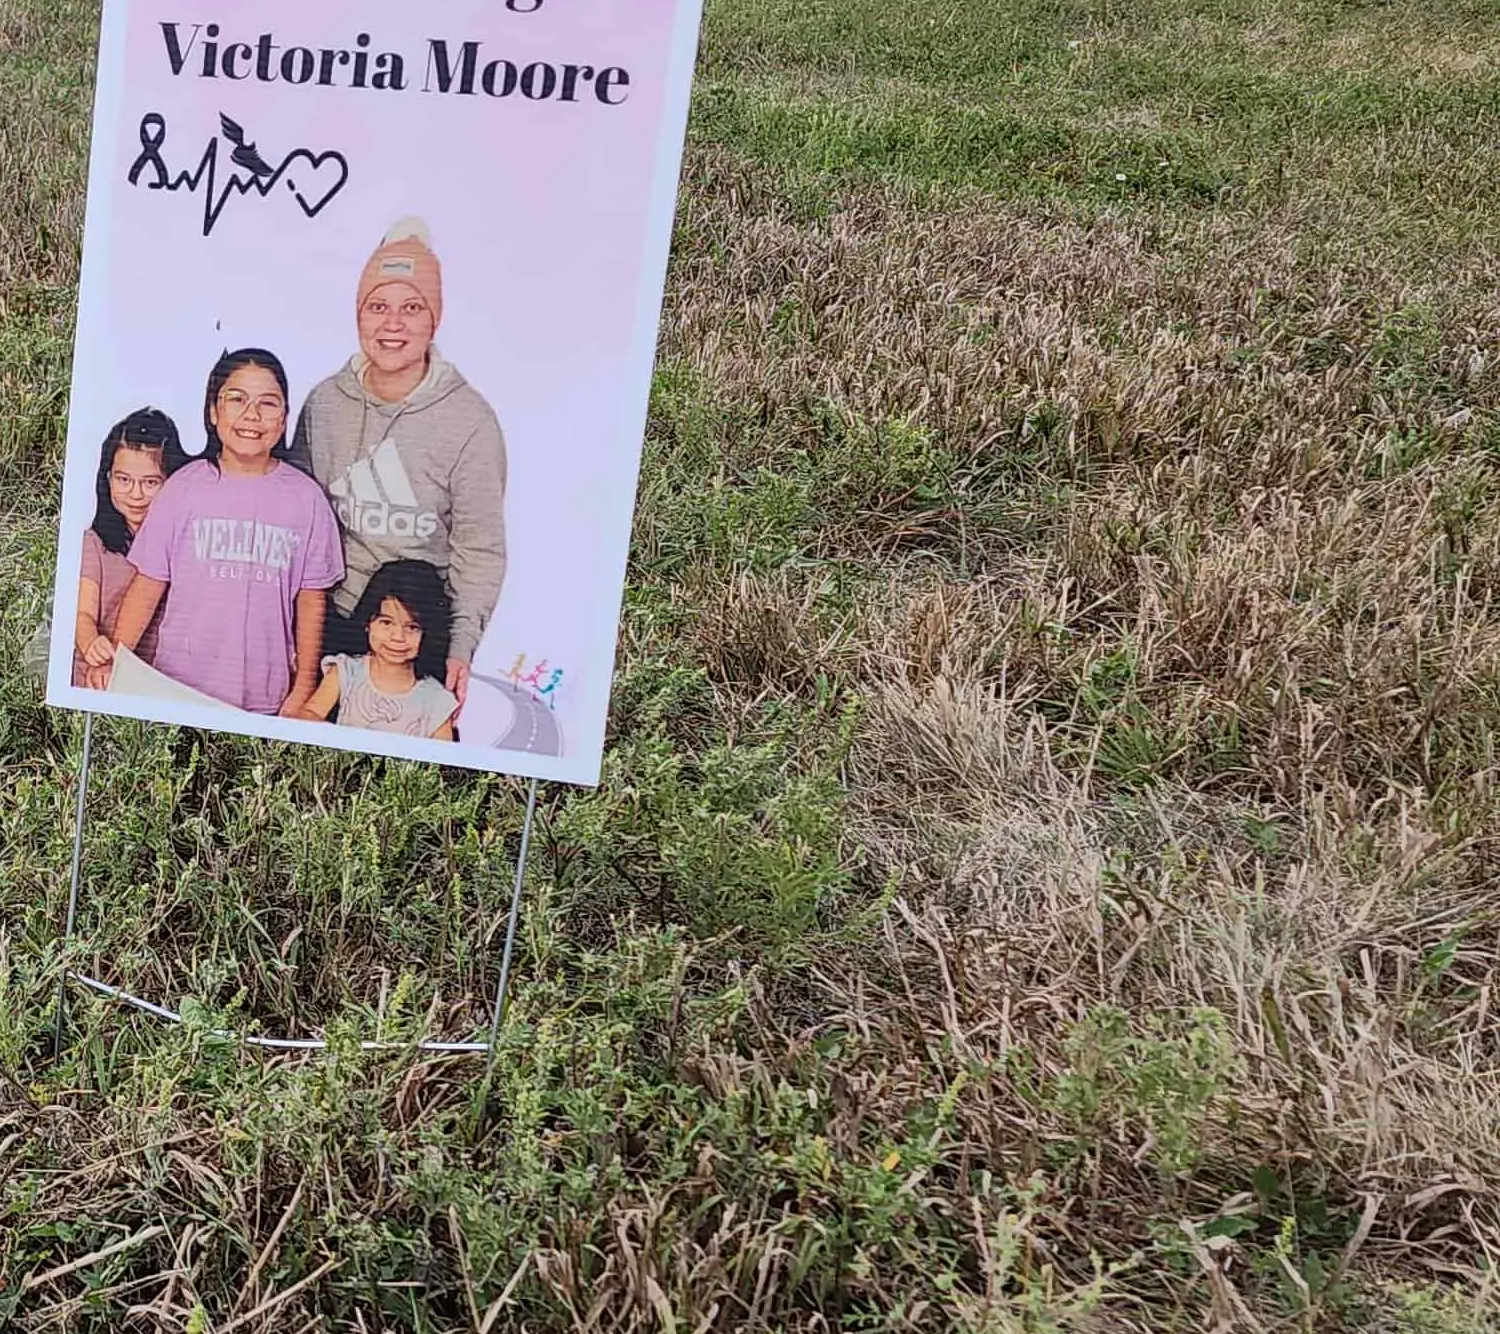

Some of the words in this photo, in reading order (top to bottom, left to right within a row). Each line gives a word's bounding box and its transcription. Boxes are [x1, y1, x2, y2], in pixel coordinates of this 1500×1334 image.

[157, 21, 408, 91] Victoria
[421, 38, 631, 106] Moore
[331, 495, 438, 539] didas
